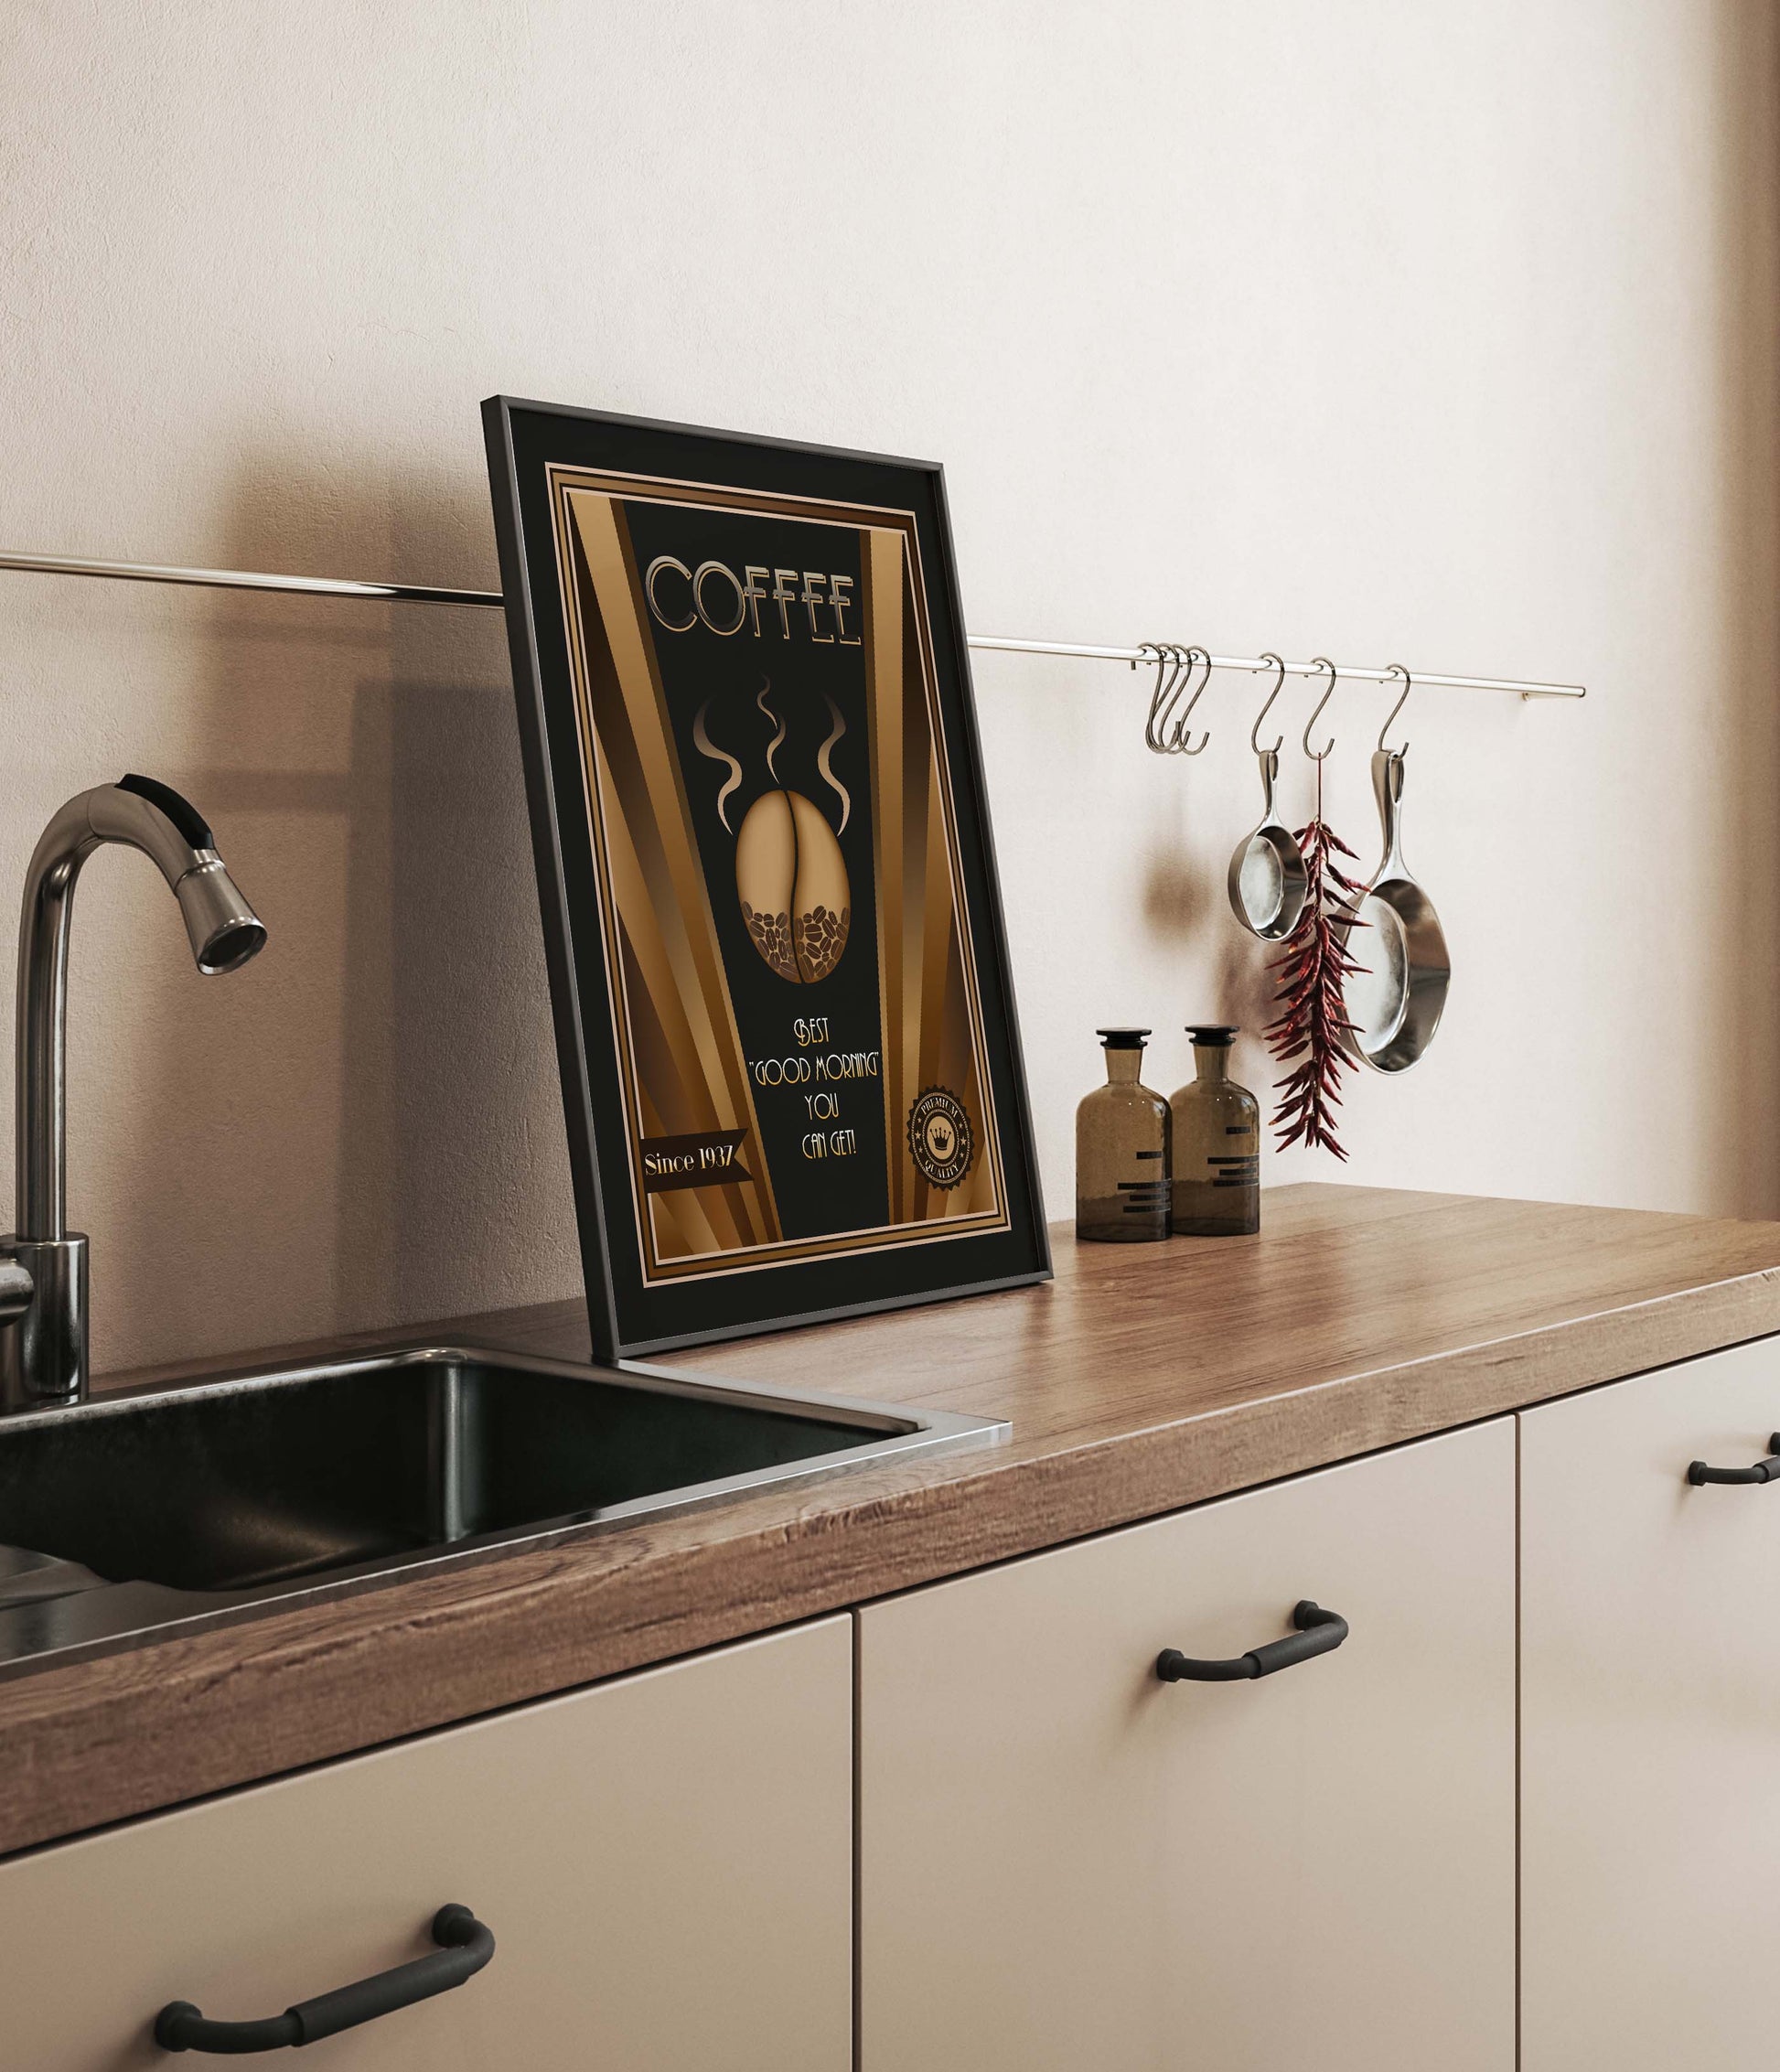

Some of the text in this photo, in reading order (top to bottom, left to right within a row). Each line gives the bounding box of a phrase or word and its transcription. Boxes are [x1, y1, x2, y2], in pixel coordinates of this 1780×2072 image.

[646, 555, 862, 646] COFFEE
[748, 1051, 879, 1086] "GOOD MORNING"
[804, 1092, 839, 1121] YOU
[920, 1097, 959, 1118] PREMIUM
[801, 1129, 857, 1159] CAN GET!
[644, 1144, 734, 1176] Since 1937
[925, 1158, 959, 1178] QUALITY
